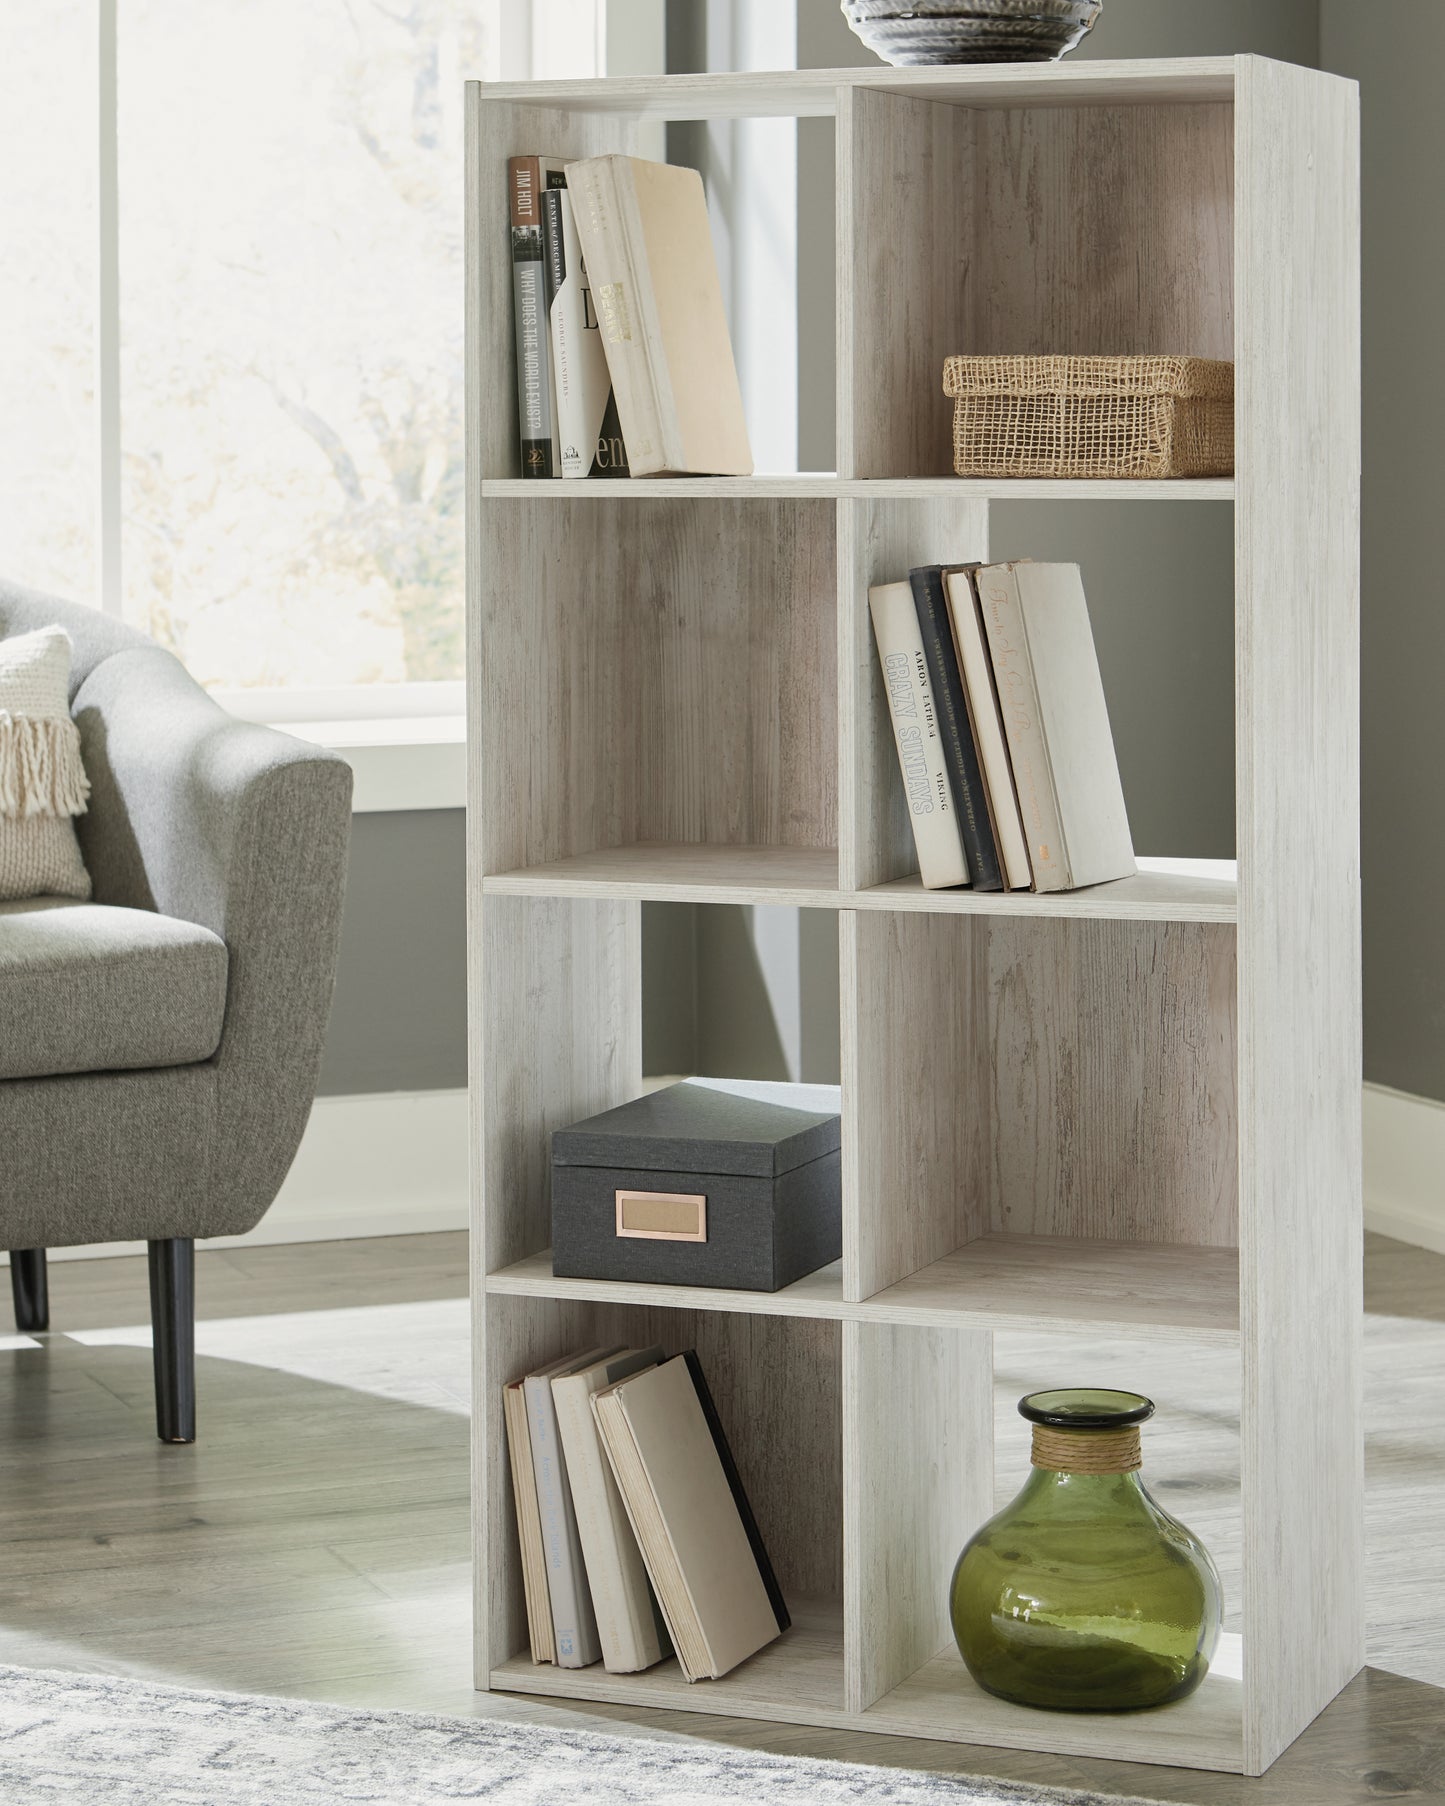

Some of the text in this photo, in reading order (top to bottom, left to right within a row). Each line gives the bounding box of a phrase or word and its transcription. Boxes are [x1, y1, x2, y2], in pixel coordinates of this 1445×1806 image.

[517, 170, 532, 216] JIM HOLT
[521, 270, 541, 428] WHY DOES THE WORLD EXIST?
[557, 311, 568, 396] GEORGE SAUNDERS
[934, 638, 948, 684] CARRIERS
[943, 688, 954, 720] MOTOR
[884, 653, 933, 815] CRAZY SUNDAYS
[914, 650, 948, 811] AARON LATHAM VIKING
[950, 724, 958, 737] OF
[954, 741, 966, 774] RIGHTS
[961, 778, 976, 831] OPERATING
[551, 1533, 561, 1568] Islands
